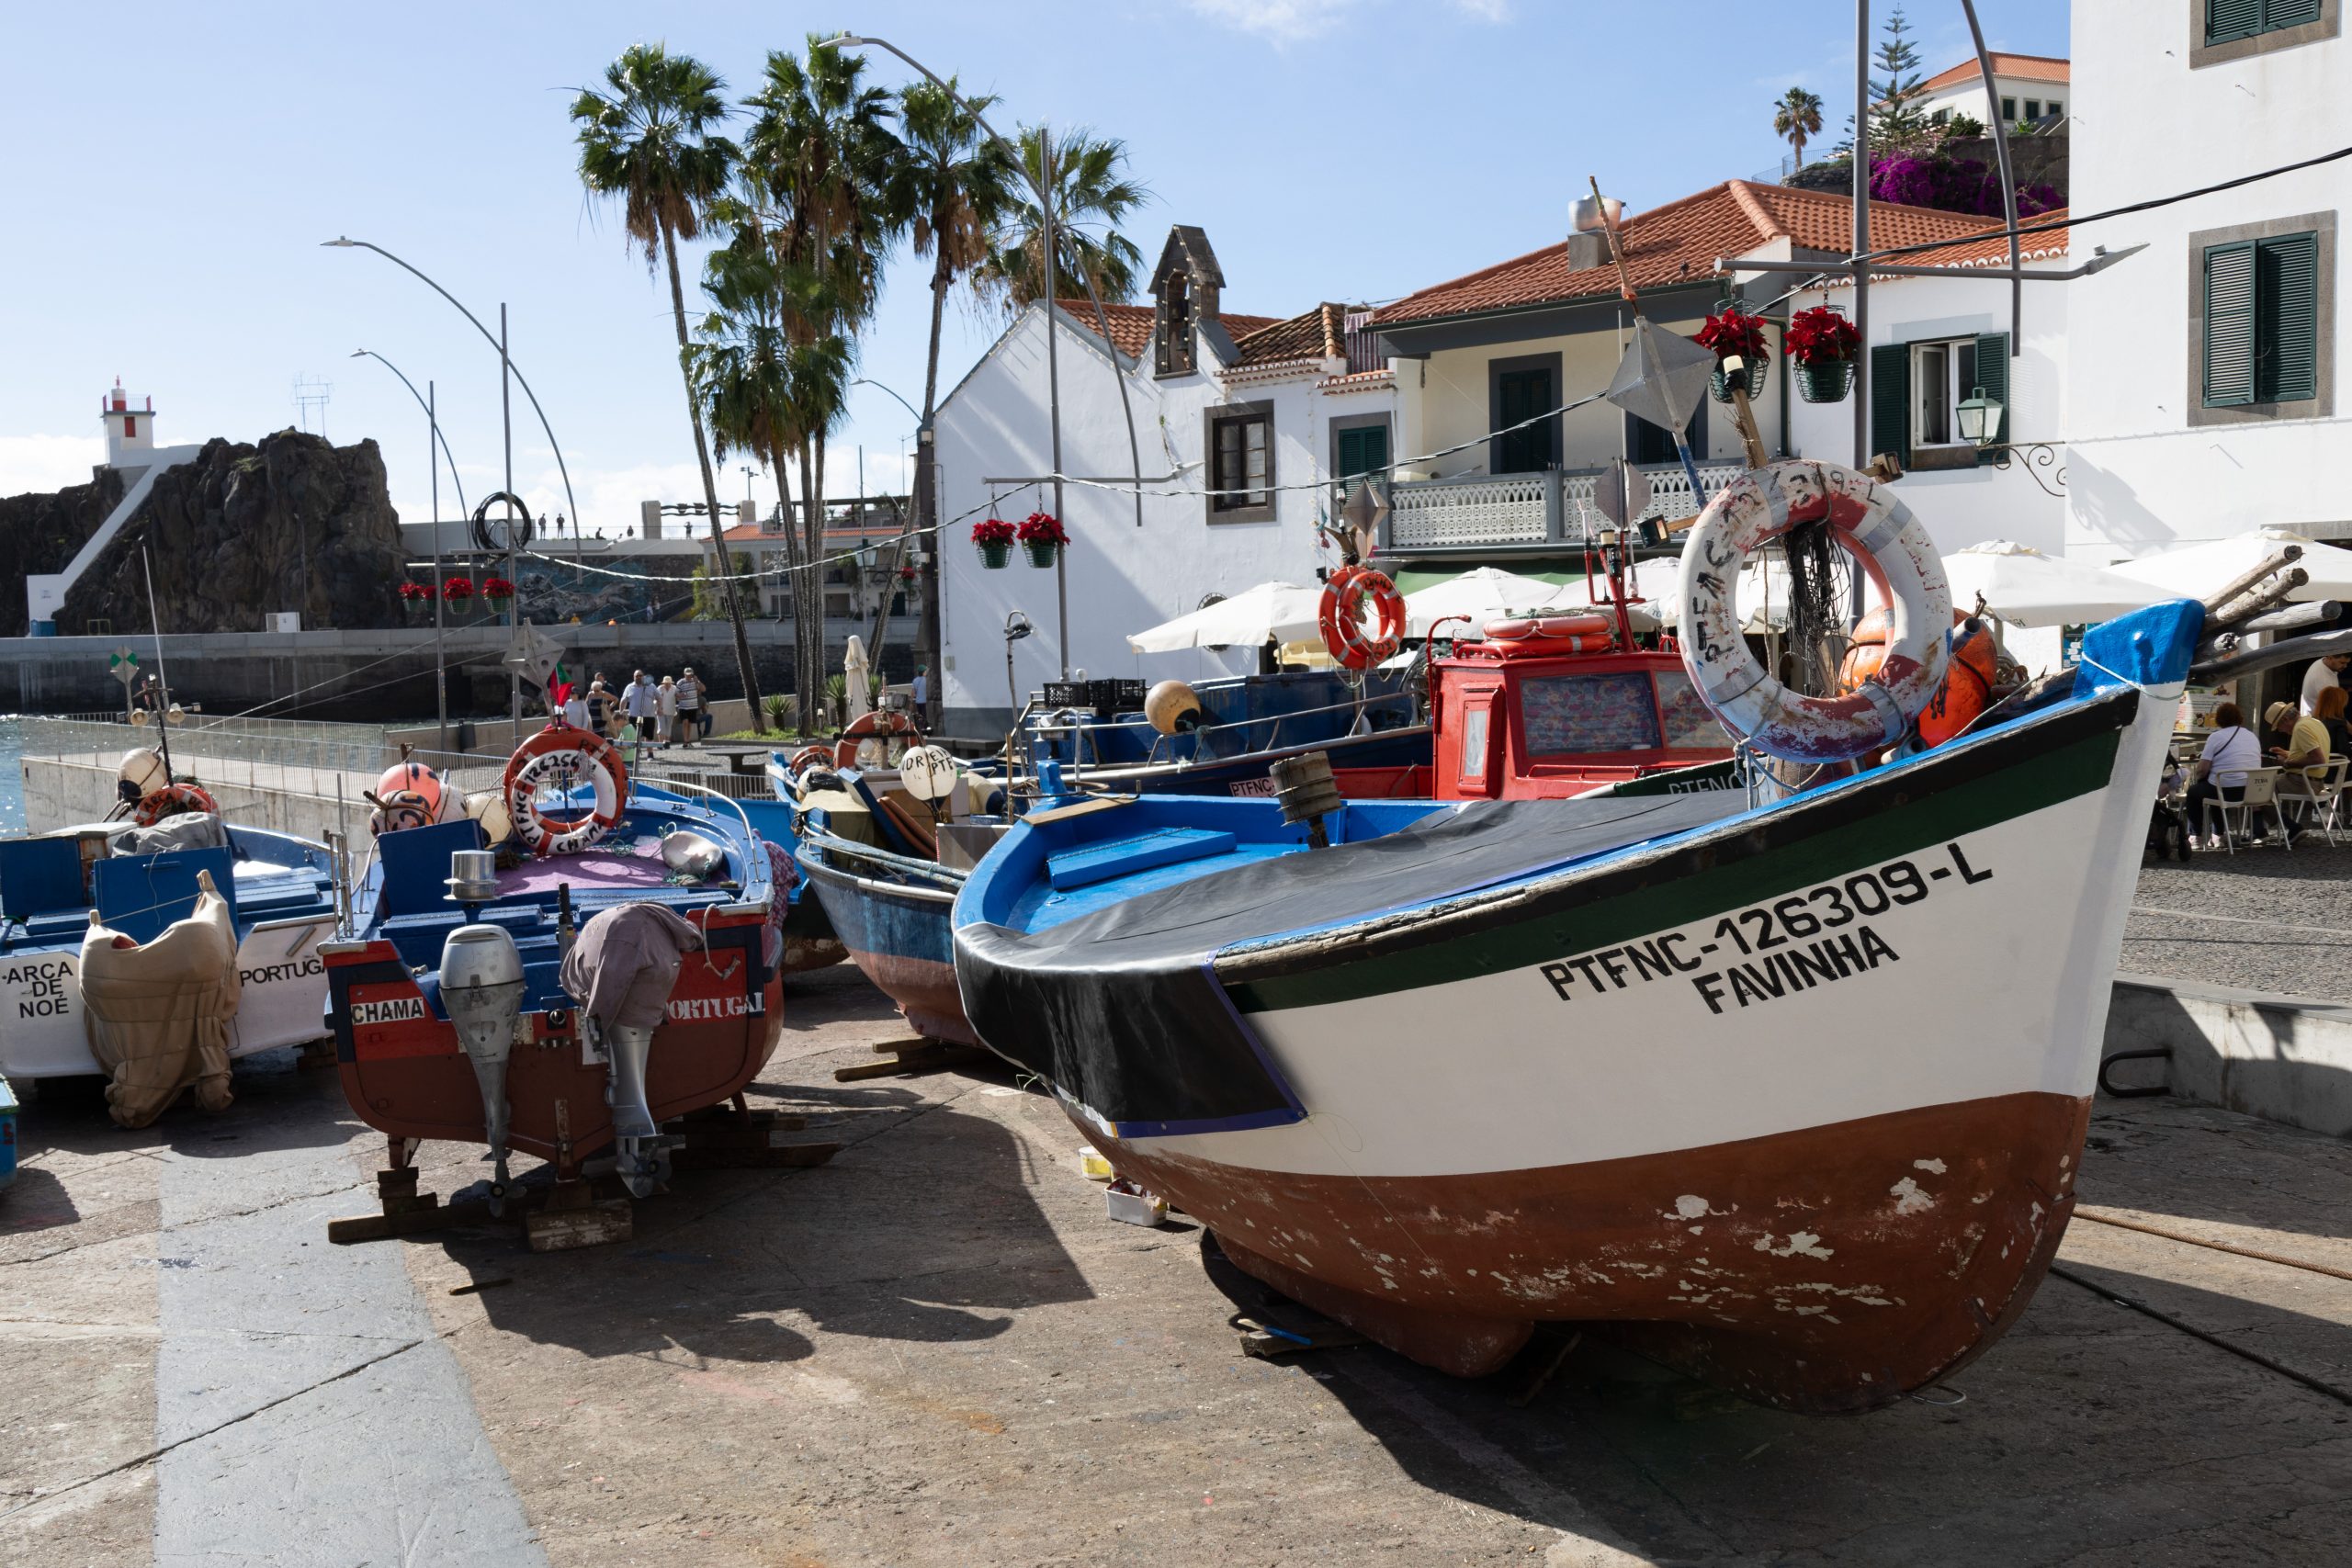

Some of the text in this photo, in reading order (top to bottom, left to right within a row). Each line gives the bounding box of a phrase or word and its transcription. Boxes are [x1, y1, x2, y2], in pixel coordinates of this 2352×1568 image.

[1539, 842, 1993, 1001] PTFNC-126309-L
[6, 961, 74, 985] ARCA
[239, 959, 325, 987] PORTUG
[1691, 925, 1900, 1014] FAVINHA
[32, 978, 63, 998] DE
[19, 994, 69, 1019] NOÉ
[352, 998, 424, 1024] CHAMA
[665, 992, 766, 1021] ORTUGAL
